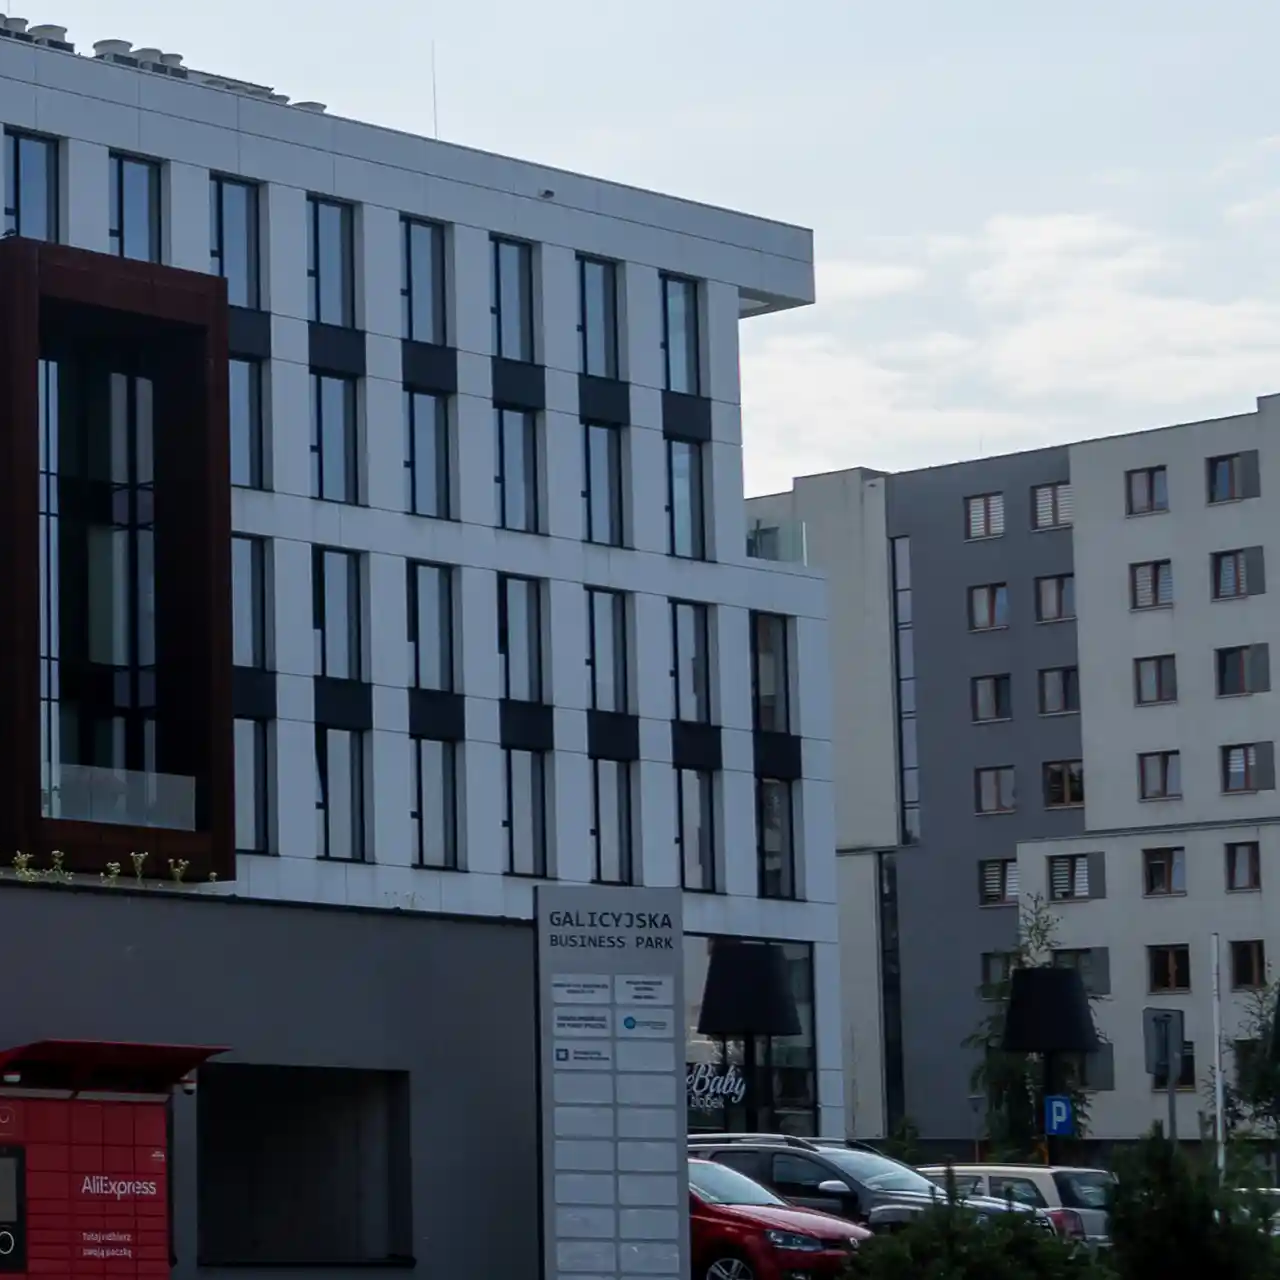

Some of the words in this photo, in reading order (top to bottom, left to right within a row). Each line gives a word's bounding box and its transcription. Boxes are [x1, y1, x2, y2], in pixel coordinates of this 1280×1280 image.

[549, 911, 672, 929] GALICYJSKA
[549, 934, 626, 948] BUSINESS
[635, 936, 673, 949] PARK
[1052, 1101, 1067, 1130] P
[81, 1176, 157, 1201] AliExpress
